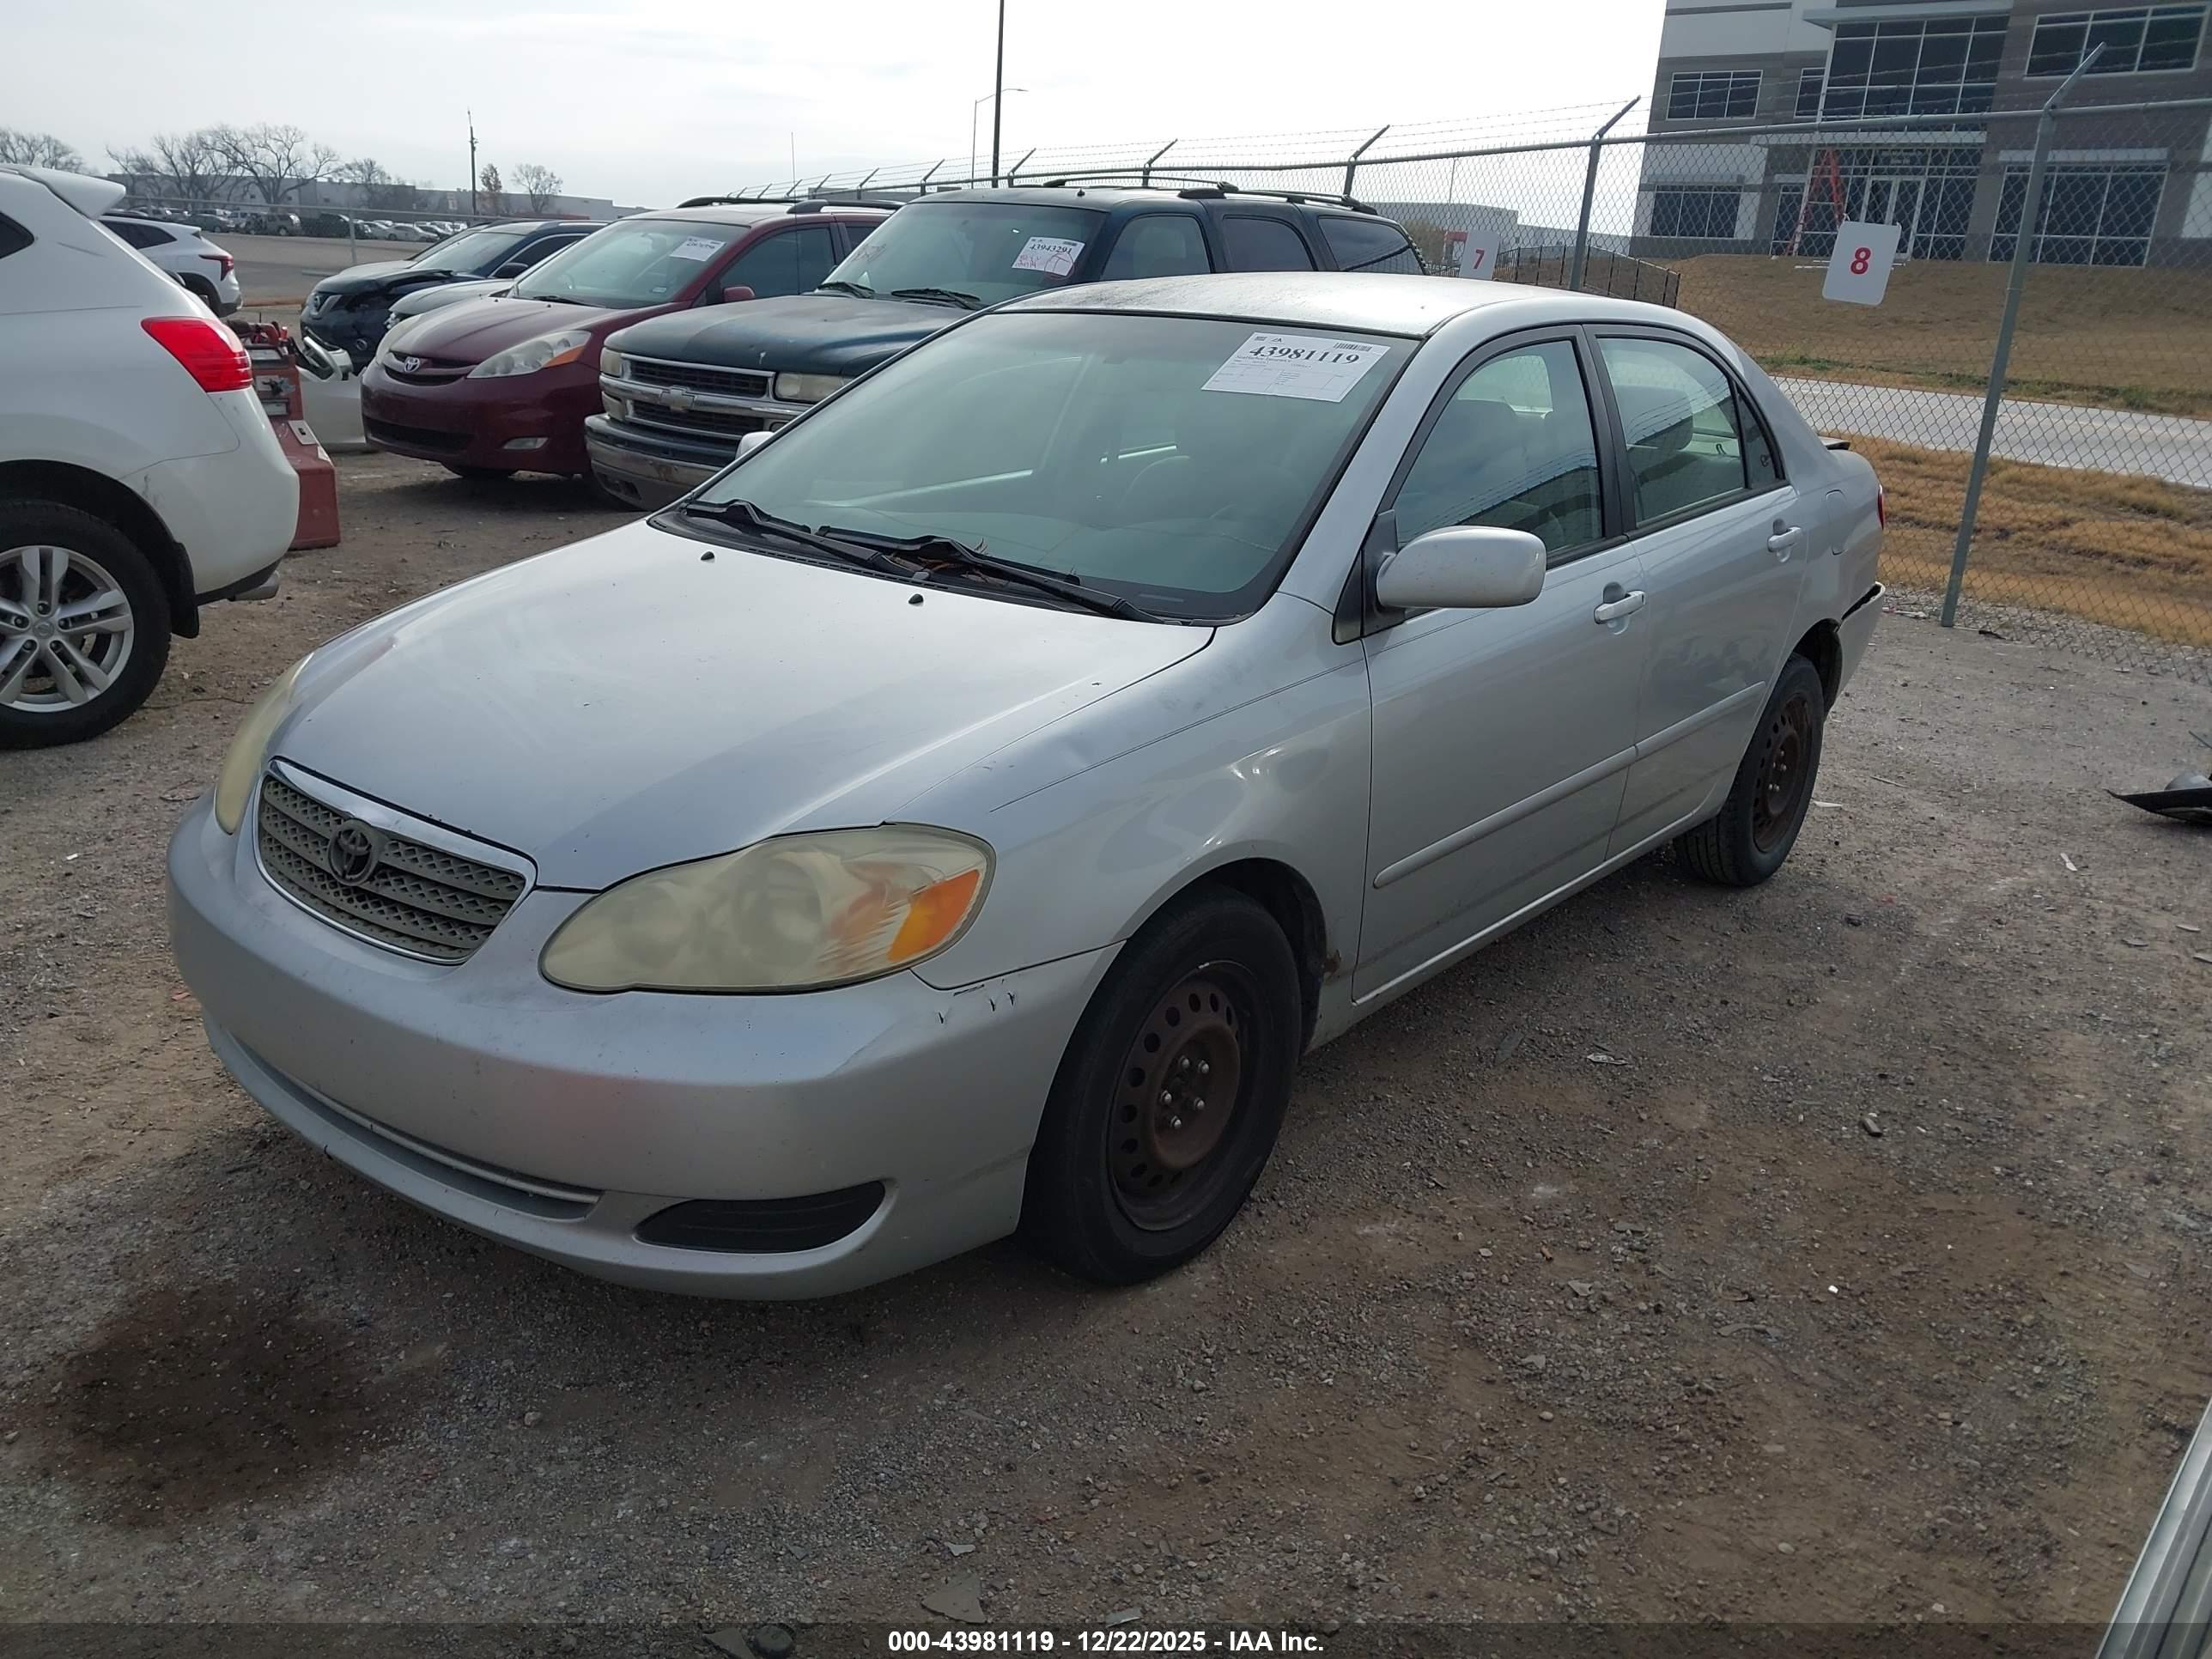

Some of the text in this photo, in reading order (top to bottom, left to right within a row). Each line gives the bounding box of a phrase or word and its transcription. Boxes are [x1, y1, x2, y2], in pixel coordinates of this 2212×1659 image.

[1473, 249, 1485, 270] 7
[1850, 246, 1872, 275] 8
[1249, 345, 1360, 365] 43981119
